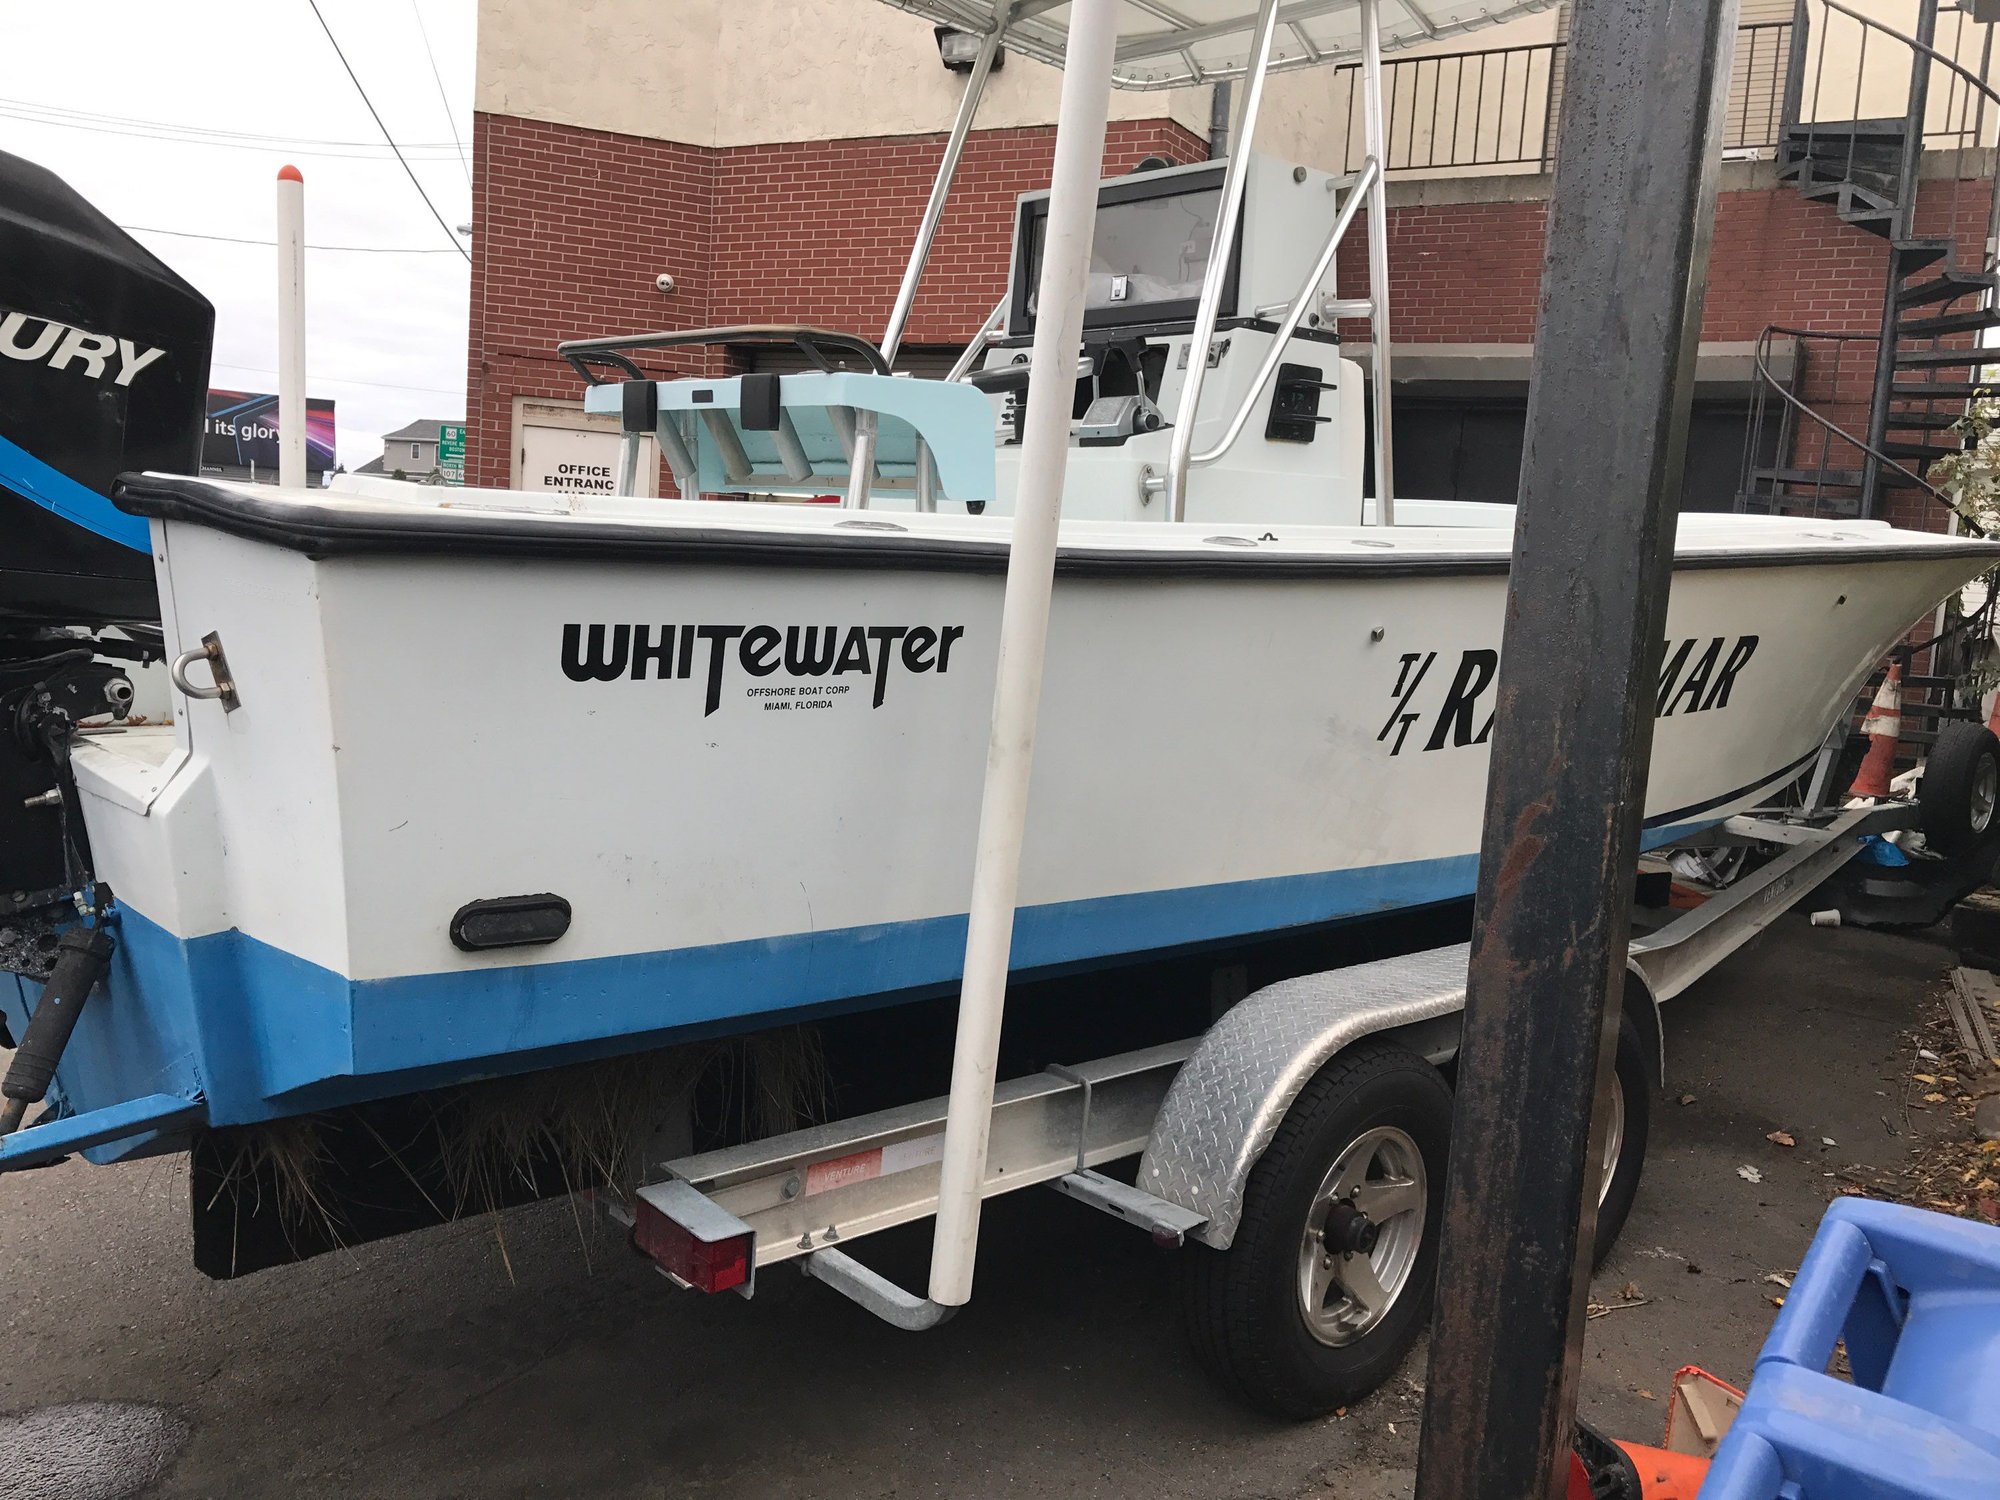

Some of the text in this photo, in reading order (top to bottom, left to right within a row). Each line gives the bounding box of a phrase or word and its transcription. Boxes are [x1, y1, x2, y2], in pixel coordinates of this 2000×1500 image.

[0, 311, 167, 387] URY
[215, 419, 236, 436] its
[443, 470, 456, 478] 107
[558, 463, 611, 477] OFFICE
[544, 475, 615, 490] ENTRANC
[746, 685, 850, 697] OFFSHORE BOAT CORP
[795, 700, 833, 710] FLORIDA
[824, 1163, 867, 1182] VENTURE
